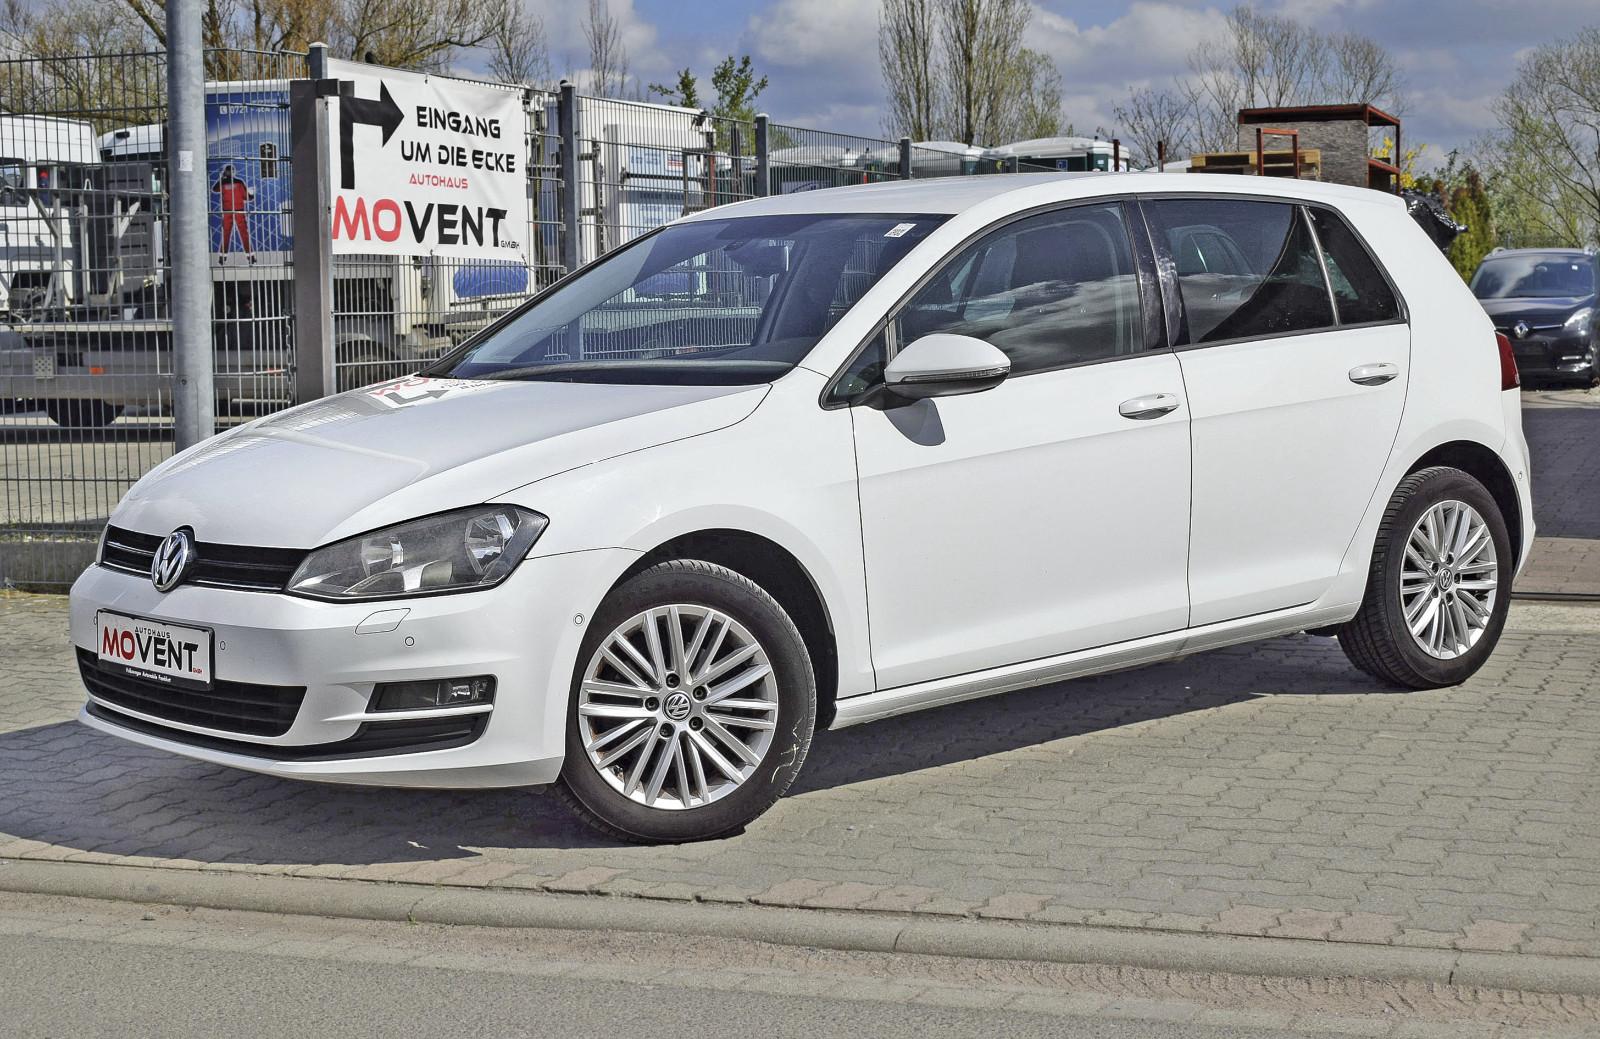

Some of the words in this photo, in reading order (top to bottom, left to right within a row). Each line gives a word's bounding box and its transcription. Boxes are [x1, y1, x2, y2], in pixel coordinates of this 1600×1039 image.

[416, 105, 501, 139] EINGANG
[401, 140, 432, 163] UM
[438, 144, 468, 167] DIE
[472, 149, 516, 173] ECKE
[409, 173, 468, 189] AUTOHAUS
[331, 195, 508, 248] MOVENT
[102, 625, 199, 672] MOVENT
[134, 626, 171, 639] AUTOHAUS
